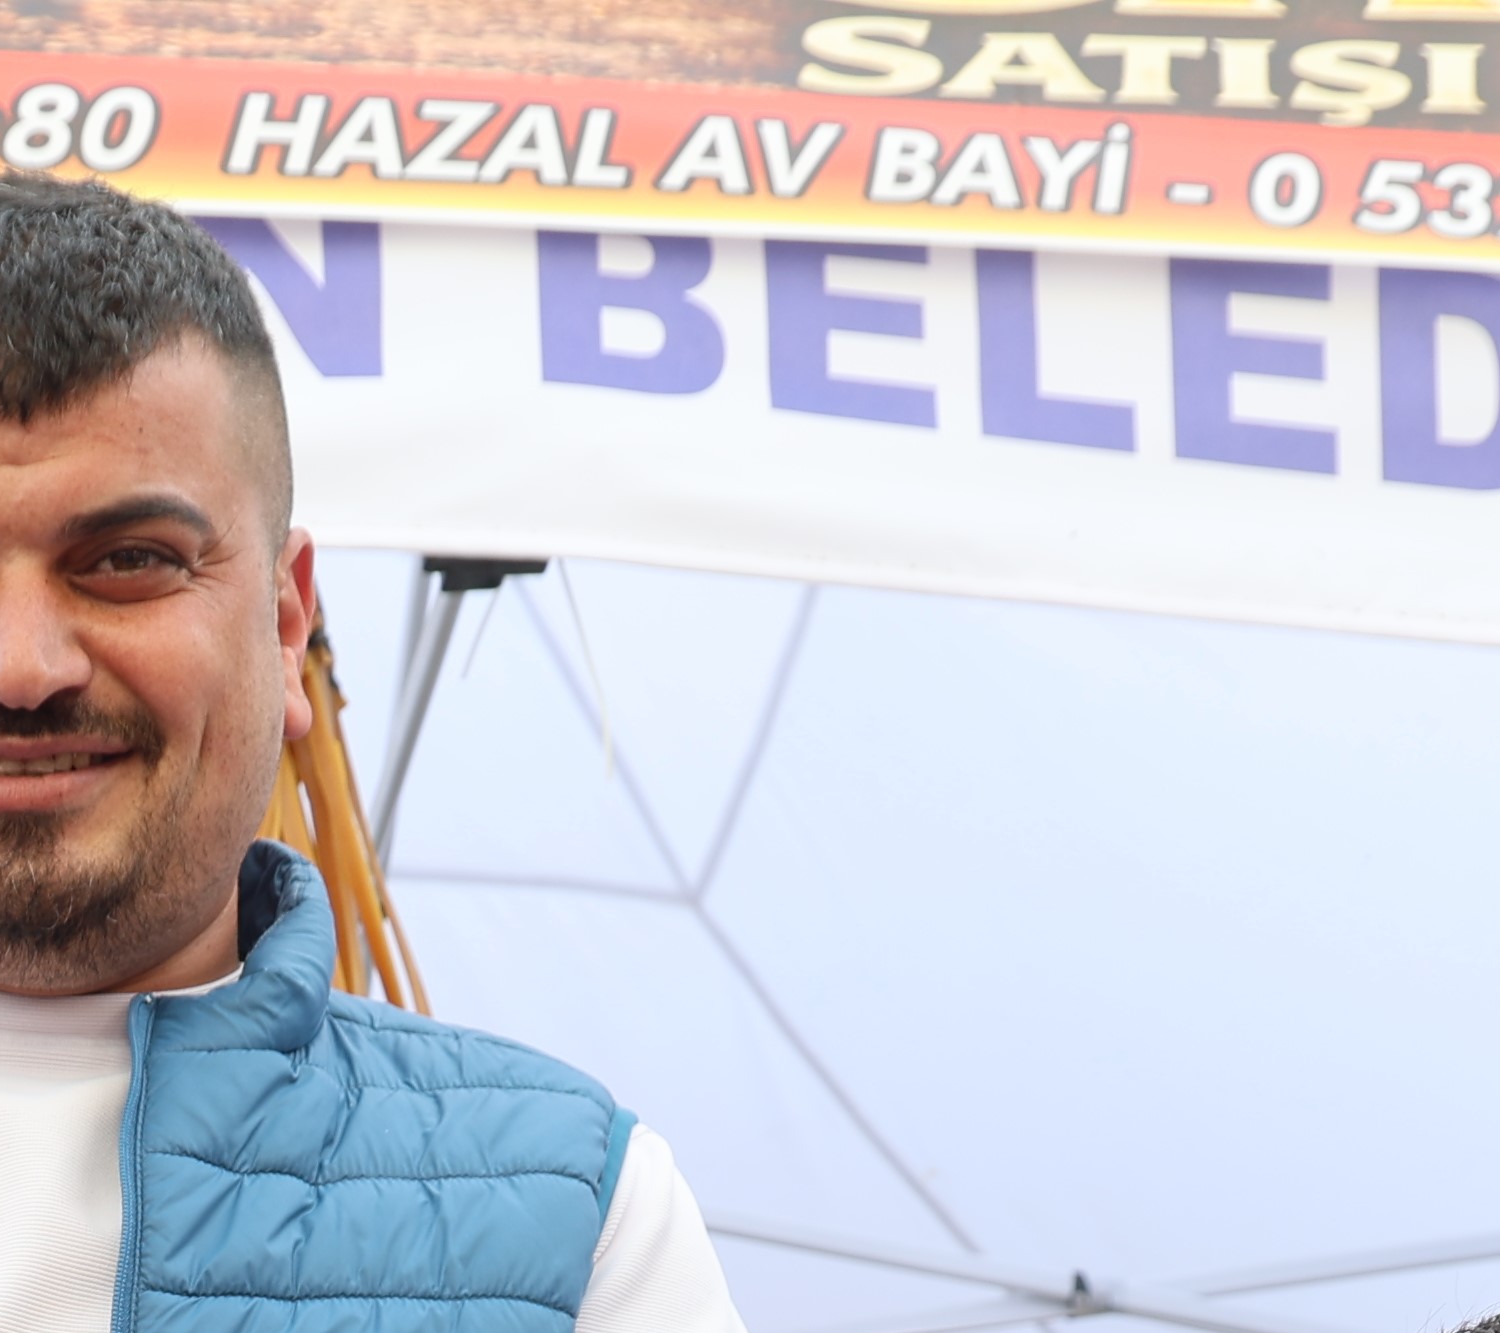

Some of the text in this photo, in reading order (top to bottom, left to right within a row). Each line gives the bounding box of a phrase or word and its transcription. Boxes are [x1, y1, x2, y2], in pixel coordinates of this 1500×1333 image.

[797, 14, 1488, 129] SATIŞI
[226, 90, 633, 192] HAZAL
[660, 115, 843, 200] AV
[866, 120, 1135, 217] BAYİ
[1248, 151, 1322, 230] 0
